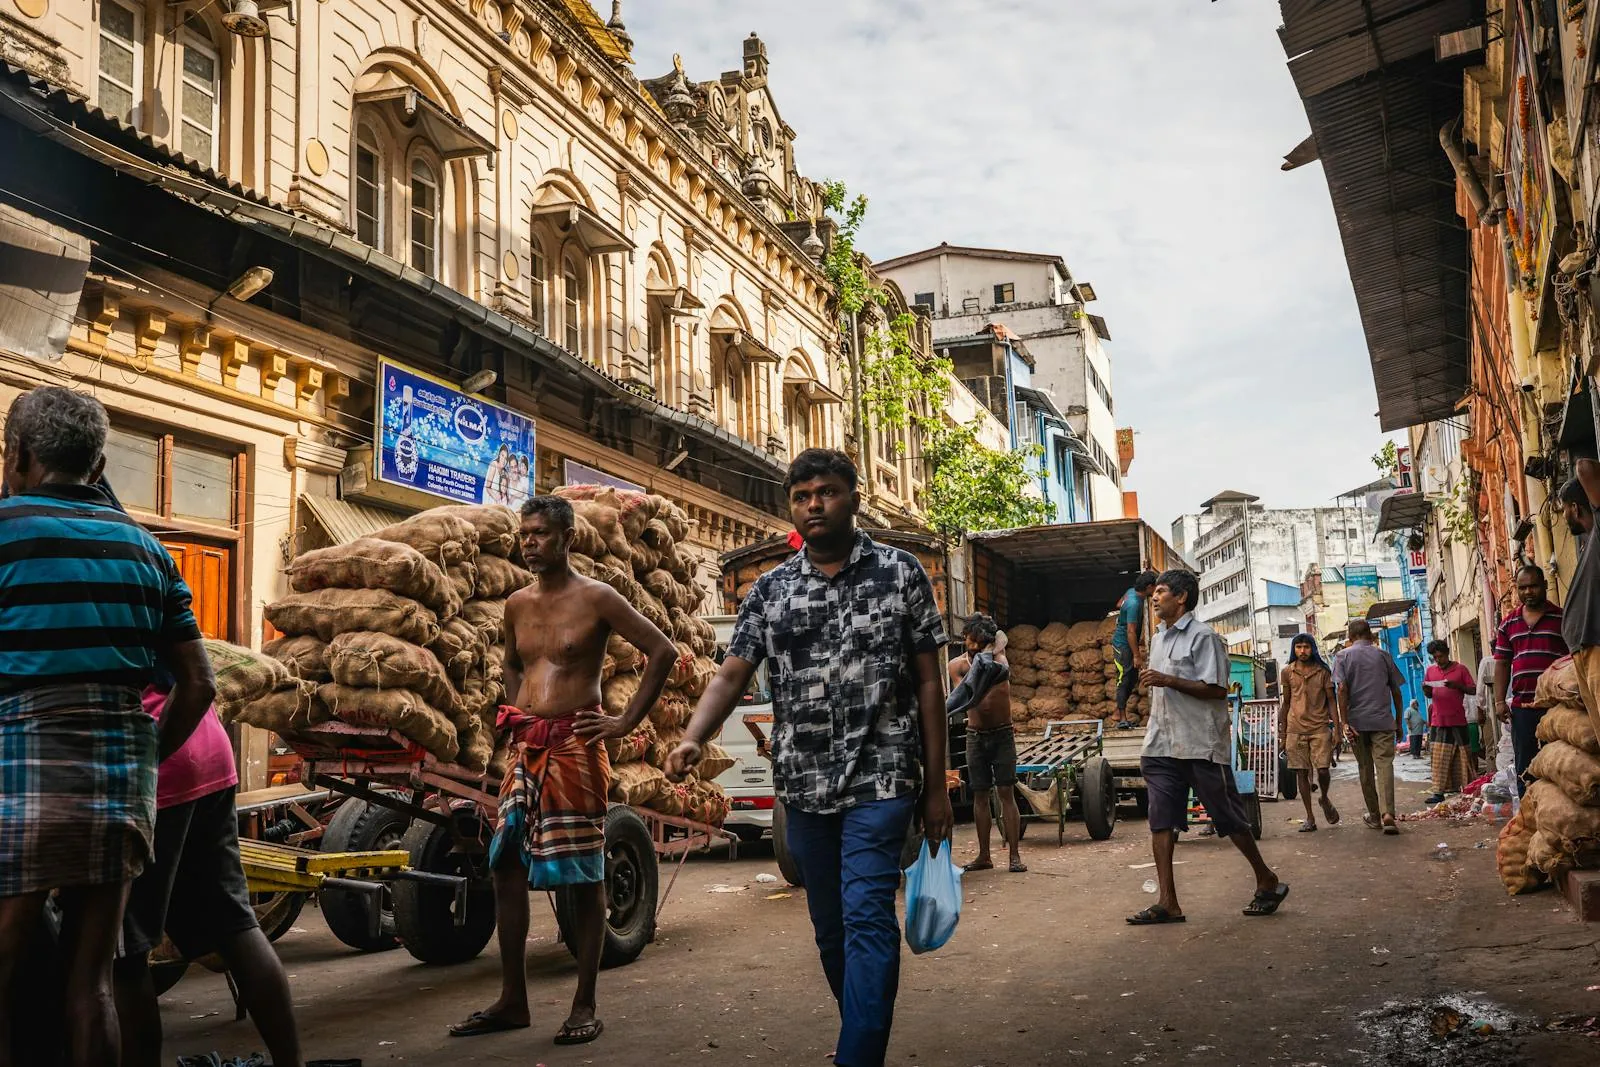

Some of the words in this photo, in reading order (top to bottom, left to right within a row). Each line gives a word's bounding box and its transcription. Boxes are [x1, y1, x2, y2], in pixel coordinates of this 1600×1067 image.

[450, 469, 476, 485] TRADERS
[427, 481, 443, 491] Colombo
[455, 481, 465, 489] Cross
